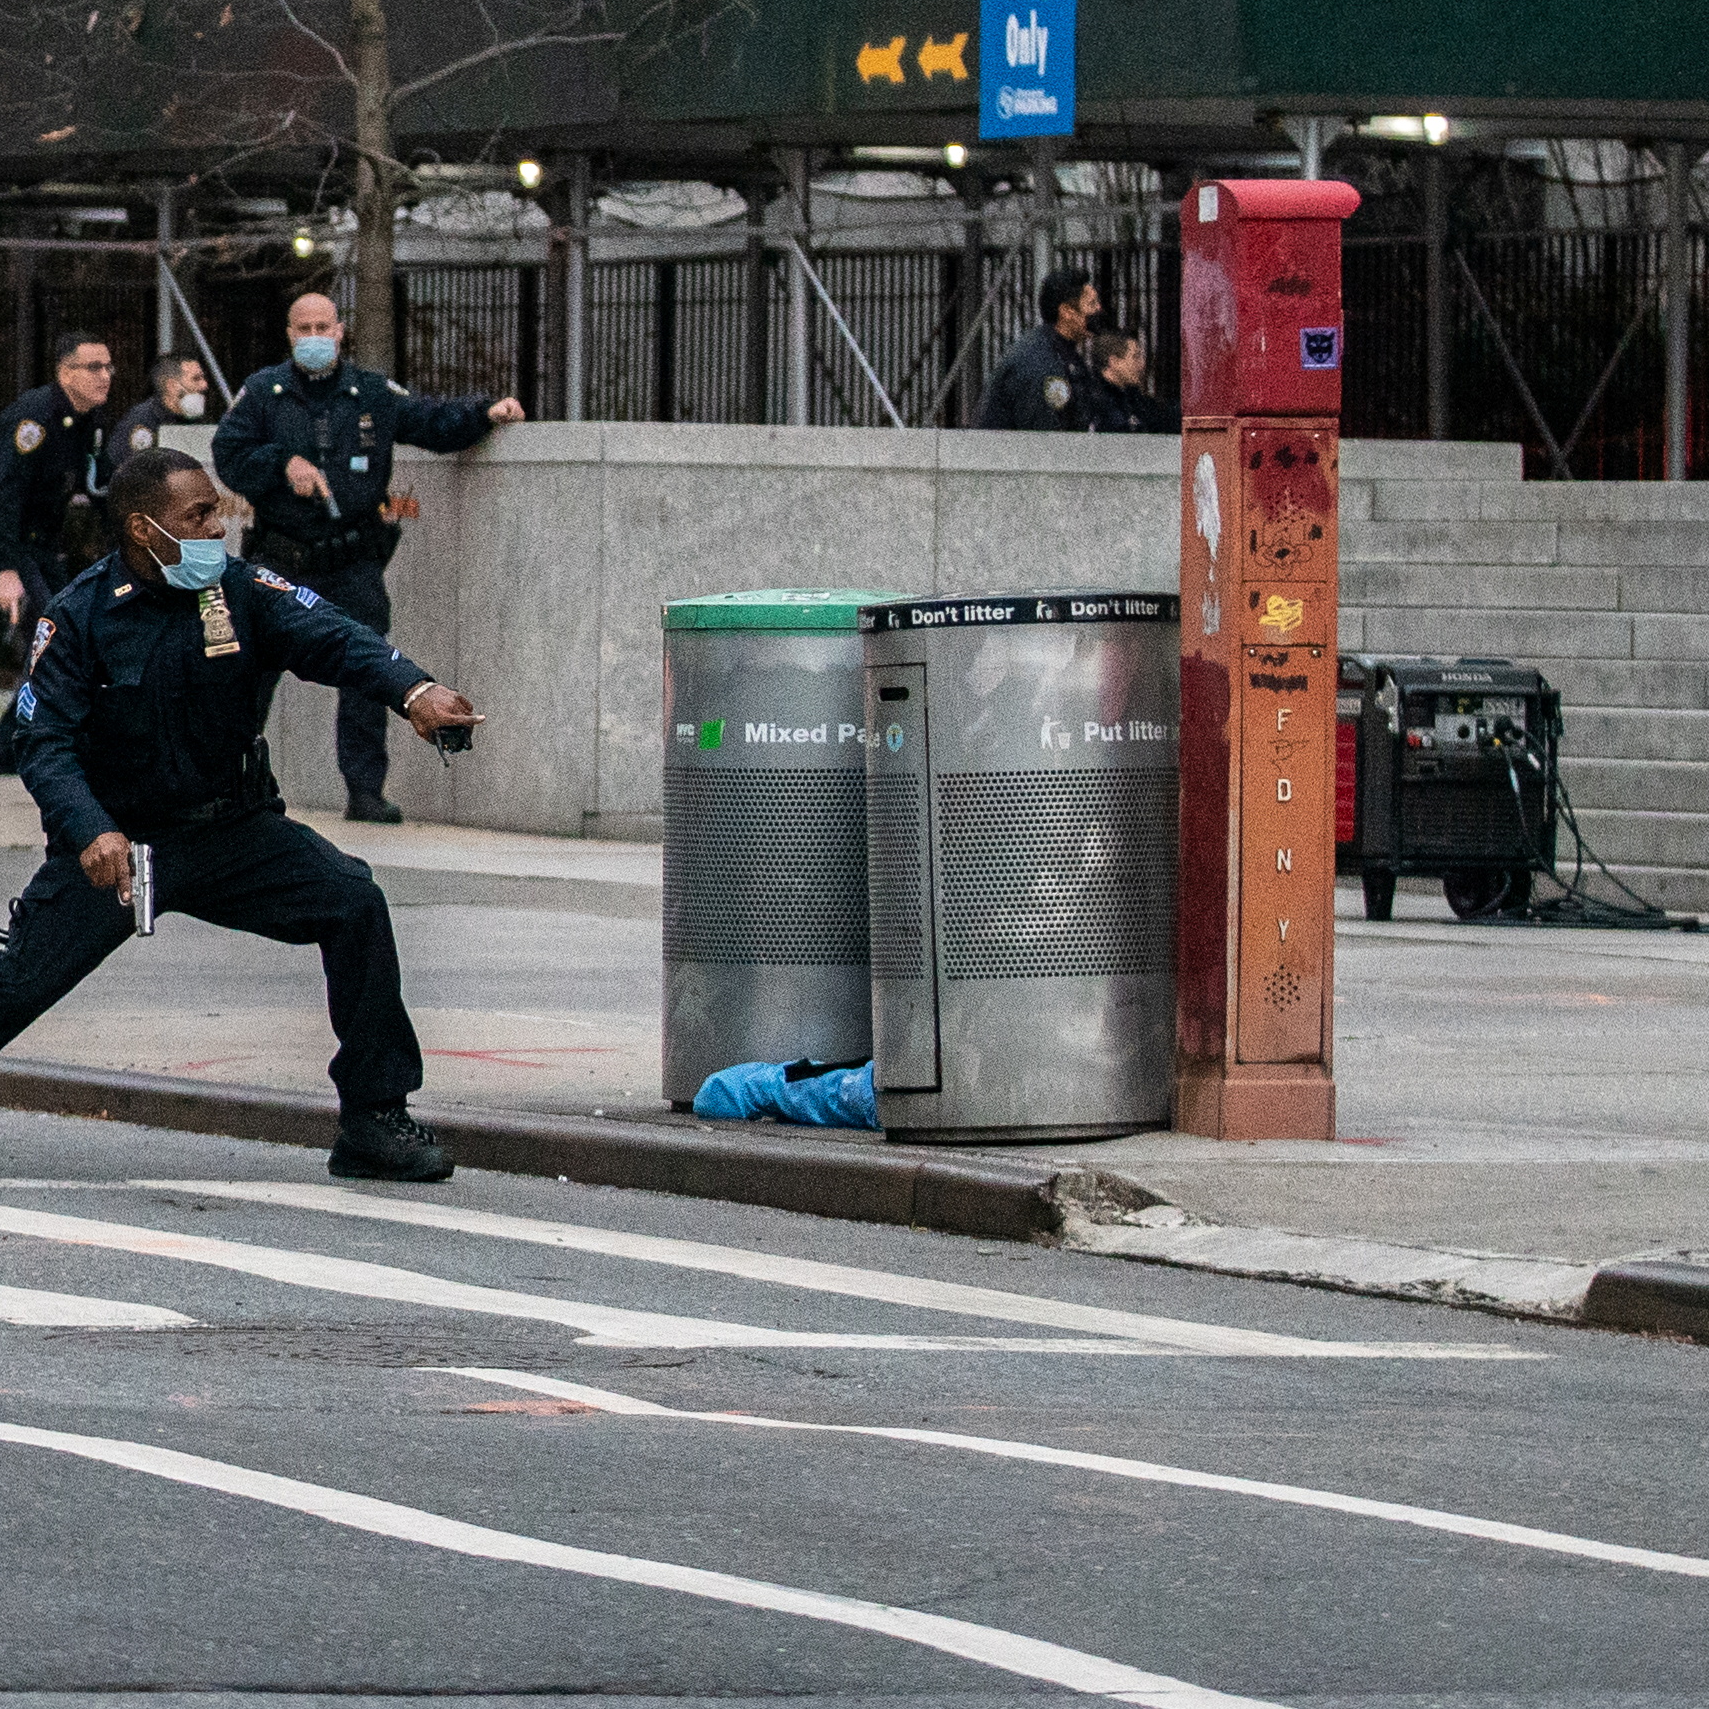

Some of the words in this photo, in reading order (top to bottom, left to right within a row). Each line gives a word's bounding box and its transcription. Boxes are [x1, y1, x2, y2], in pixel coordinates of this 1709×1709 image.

[1005, 10, 1049, 77] Only
[910, 608, 959, 625] Don't
[964, 605, 1015, 622] litter
[1070, 601, 1121, 616] Don't
[1125, 600, 1161, 616] litter
[1441, 672, 1493, 683] HONDA
[744, 722, 827, 743] Mixed
[1084, 721, 1122, 742] Put
[1128, 720, 1167, 742] litter
